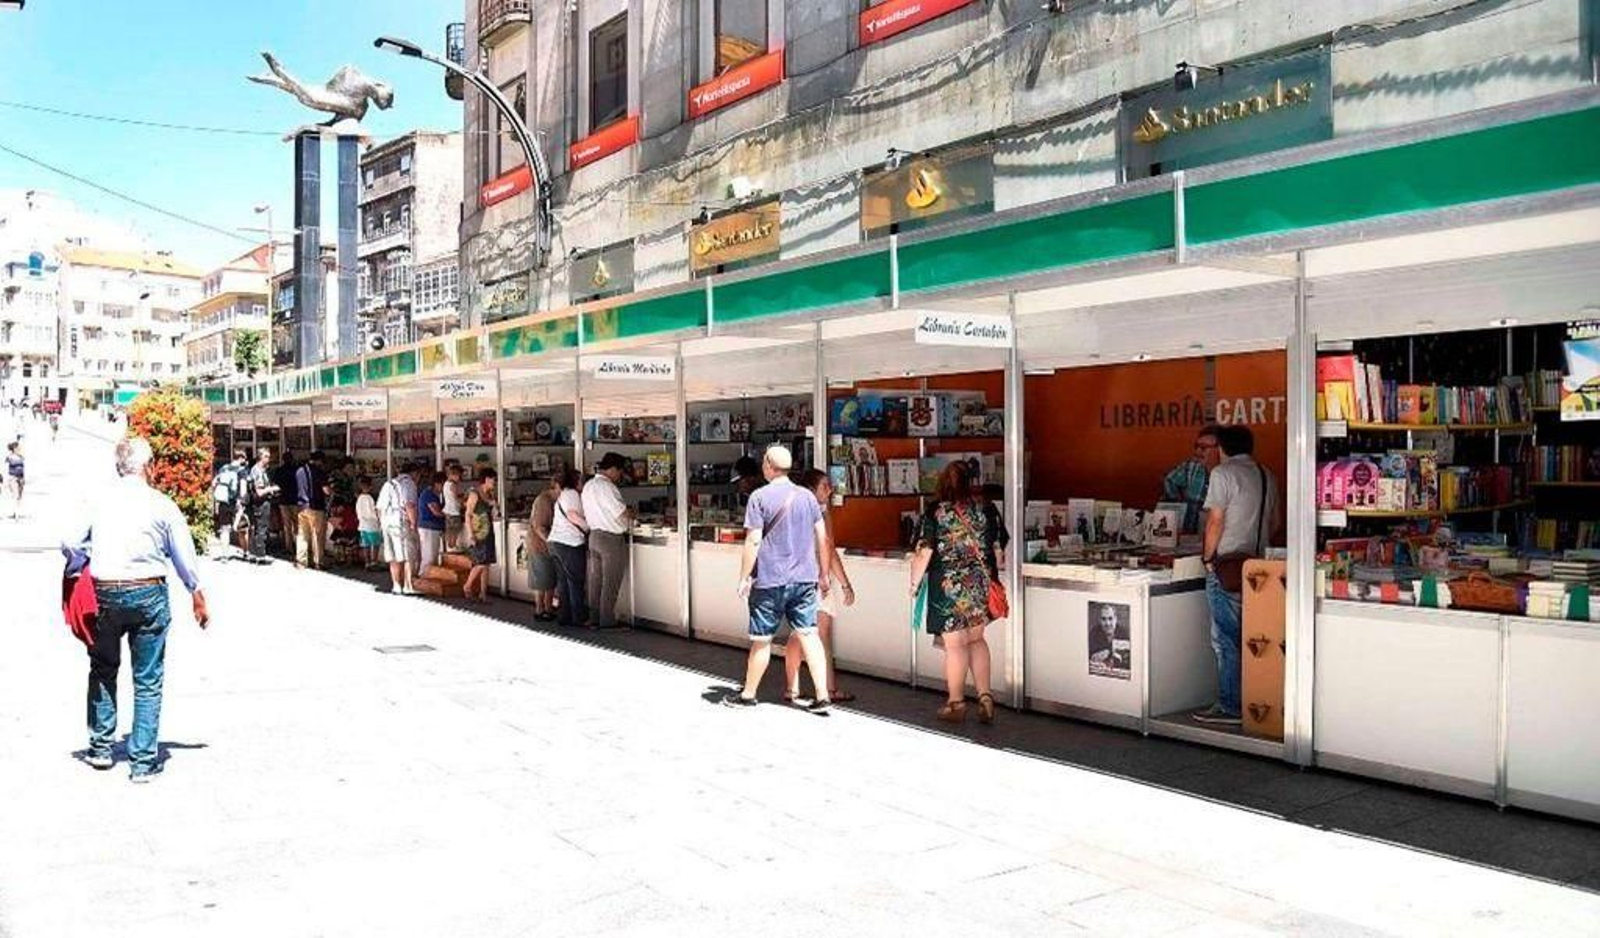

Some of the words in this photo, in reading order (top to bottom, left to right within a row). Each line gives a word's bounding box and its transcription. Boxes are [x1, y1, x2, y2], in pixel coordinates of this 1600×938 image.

[1172, 77, 1315, 132] Santander
[1100, 394, 1204, 429] LIBRARÍA
[1215, 396, 1287, 425] CART
